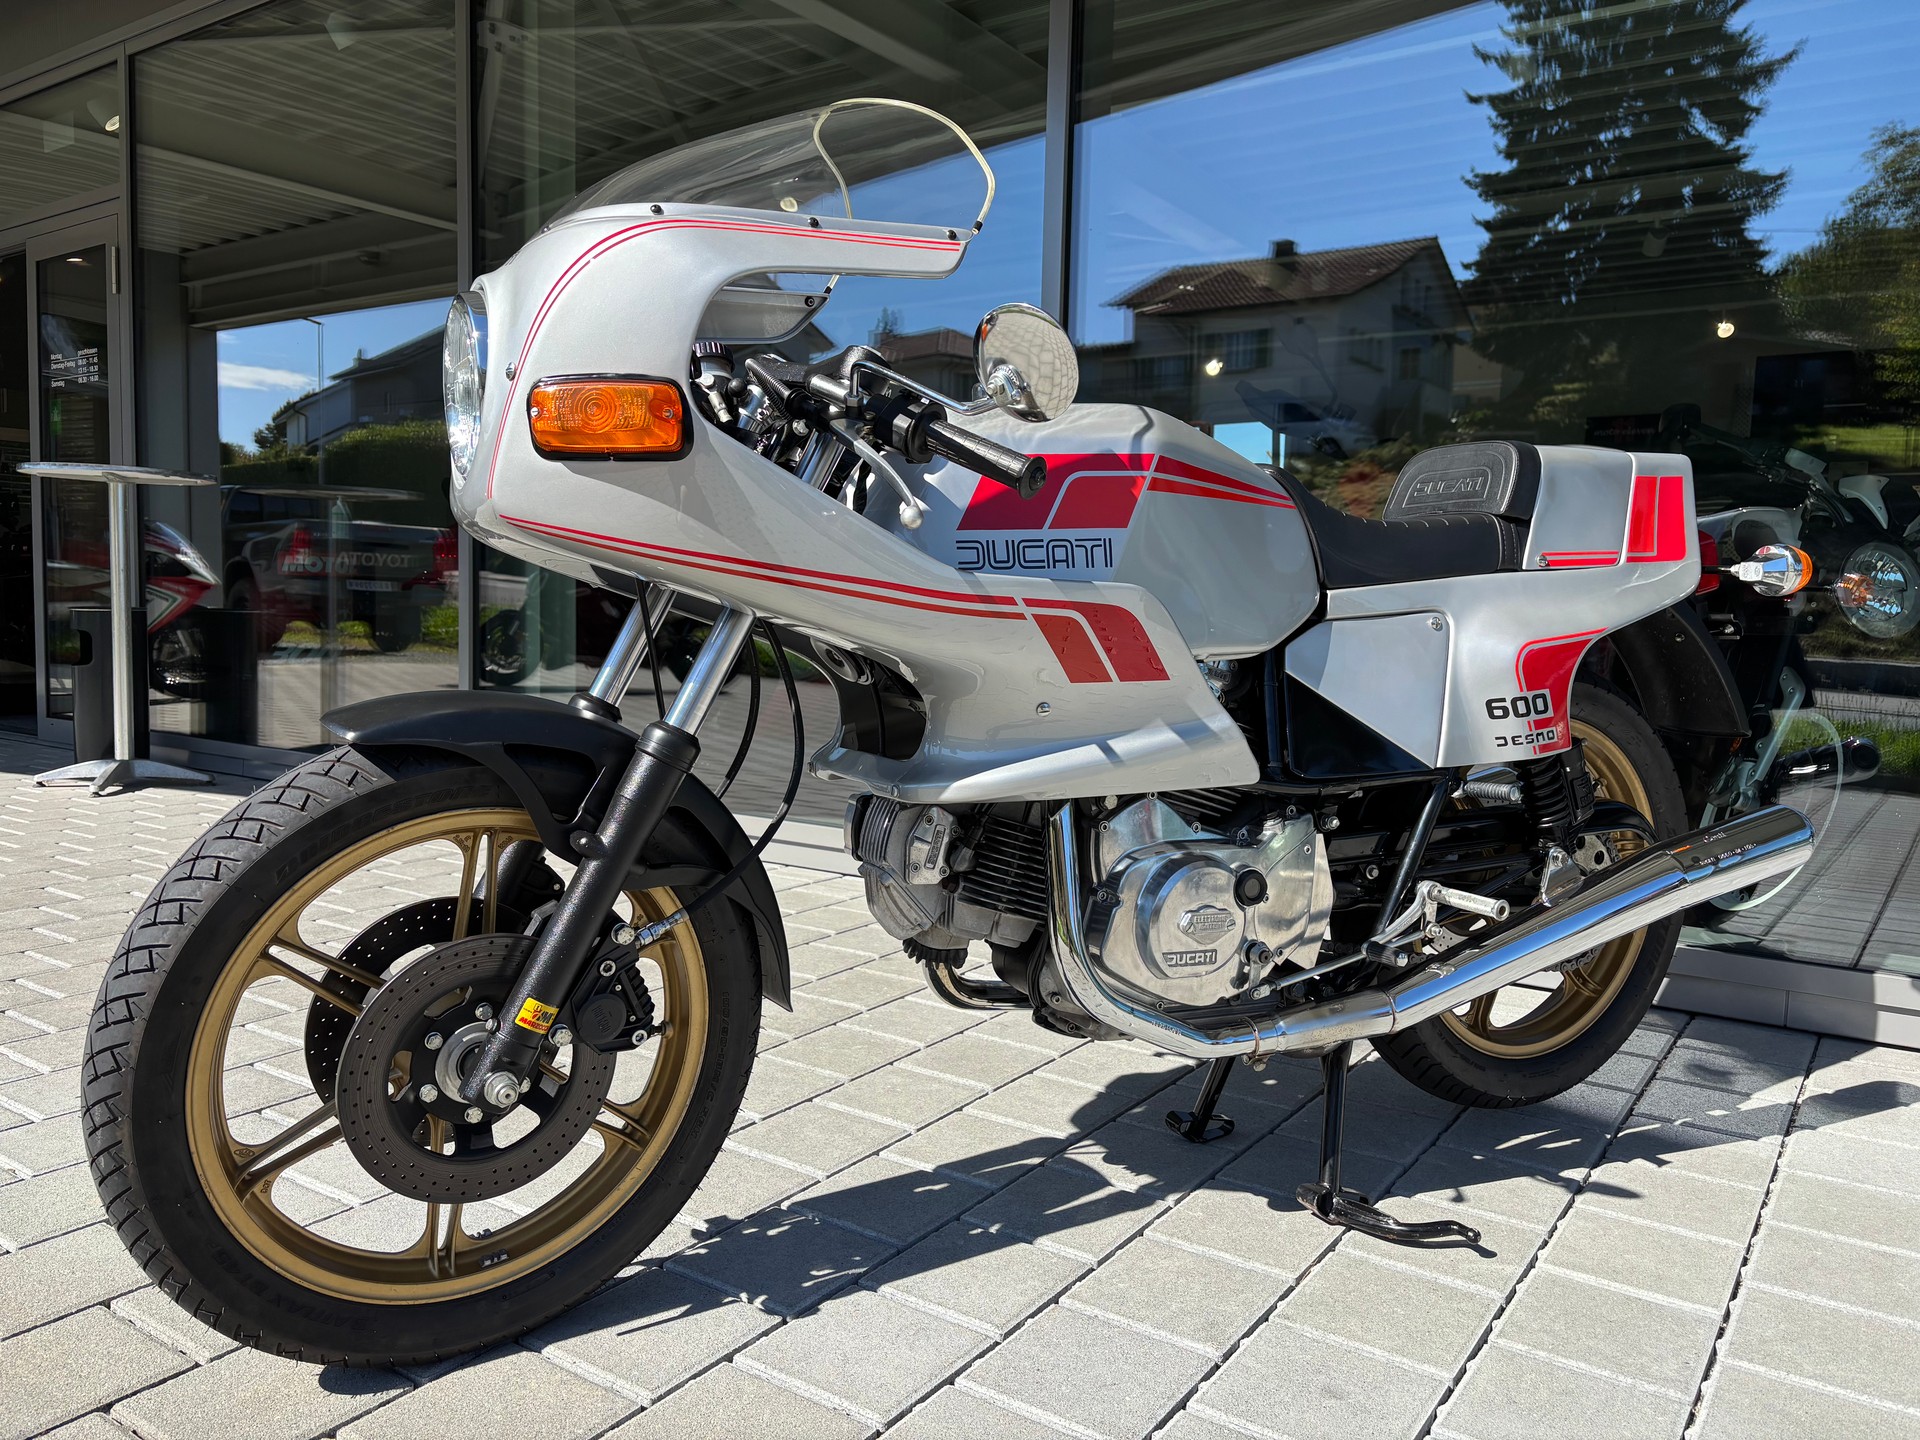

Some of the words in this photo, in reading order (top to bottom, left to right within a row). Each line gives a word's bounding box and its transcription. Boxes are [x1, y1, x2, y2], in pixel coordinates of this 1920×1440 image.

[77, 348, 97, 356] geschlossen
[1414, 476, 1485, 497] DUCATI
[956, 537, 1113, 571] DUCATI
[1485, 692, 1550, 720] 600
[1494, 729, 1556, 748] DESMO
[1166, 951, 1216, 968] DUCATI
